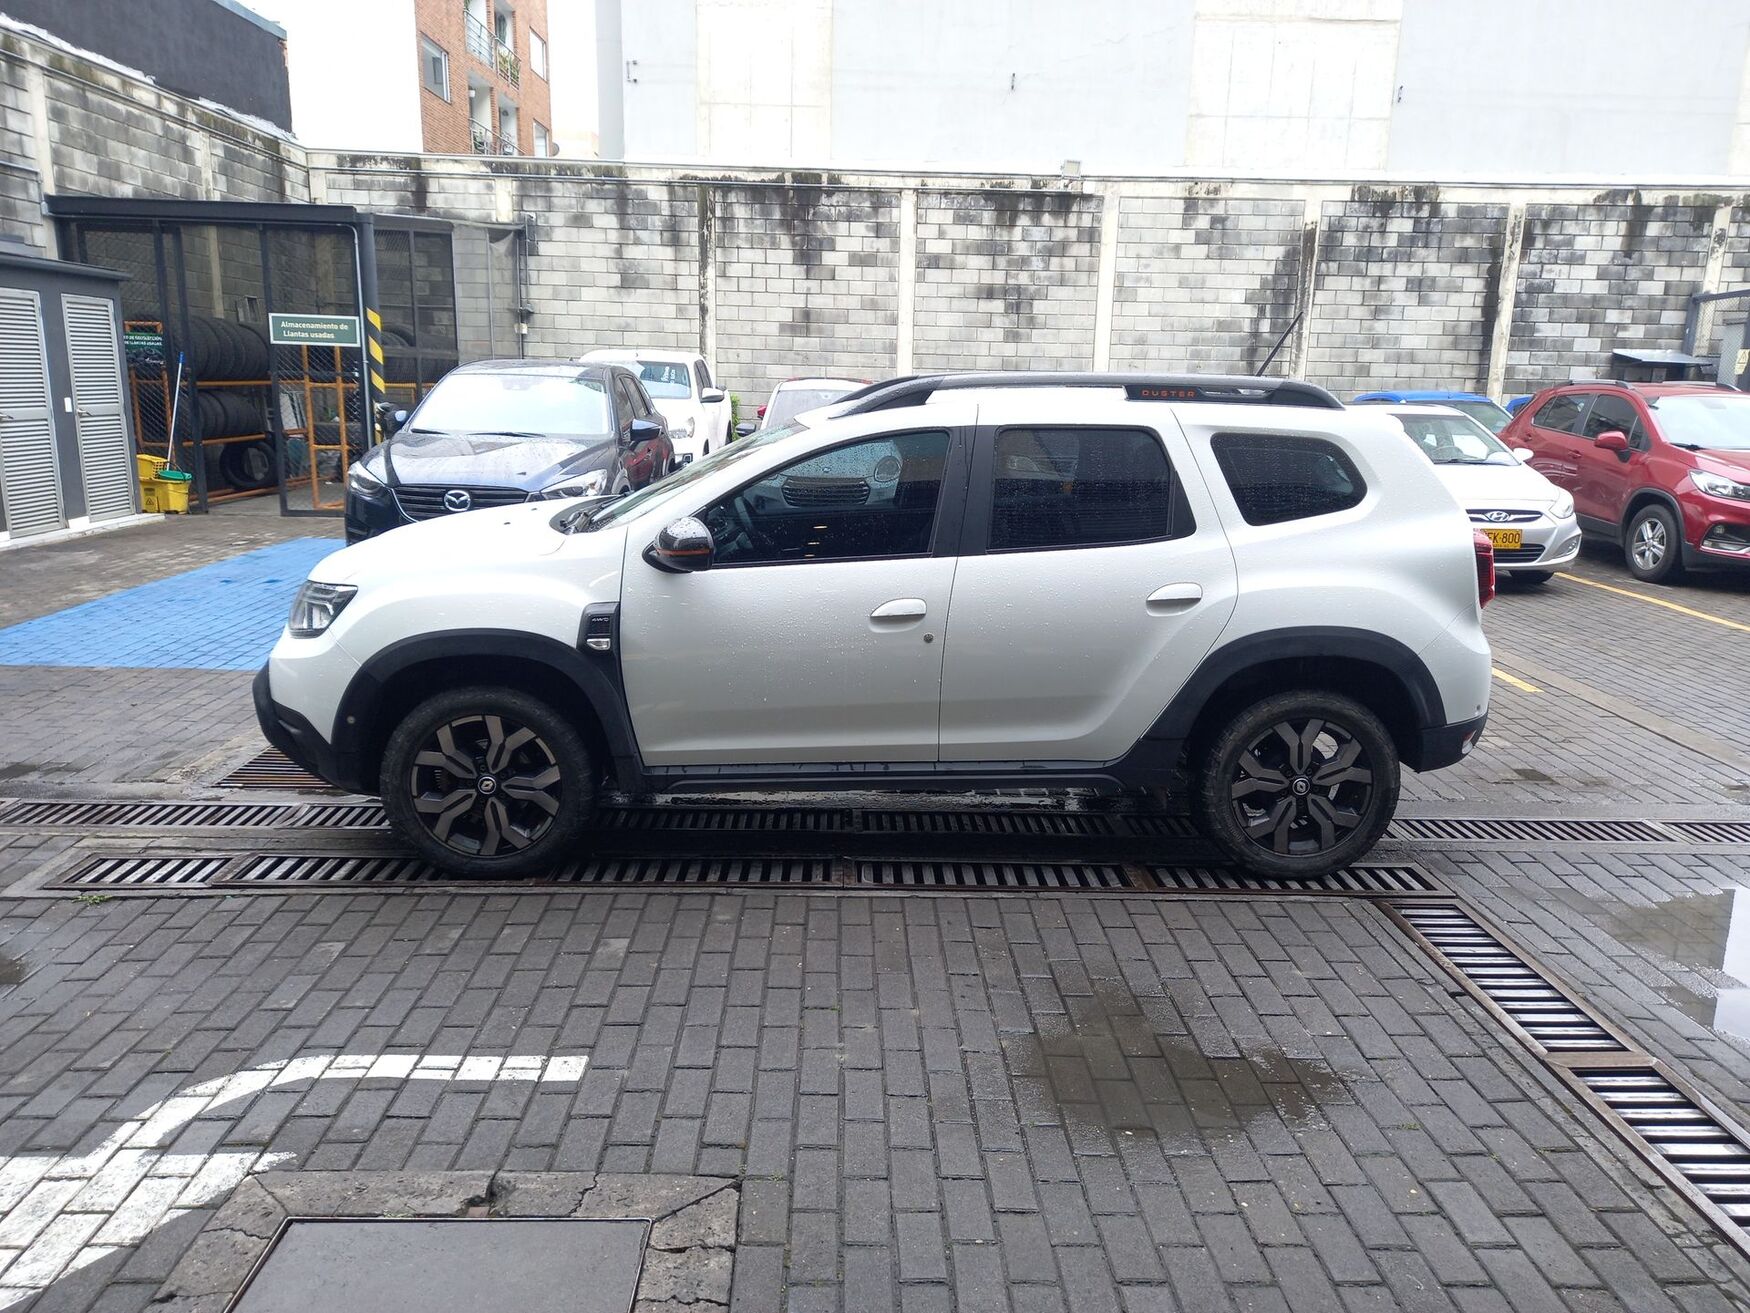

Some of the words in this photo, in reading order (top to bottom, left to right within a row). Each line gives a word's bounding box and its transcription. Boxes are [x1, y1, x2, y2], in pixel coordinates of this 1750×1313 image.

[281, 321, 338, 329] Almacenamiento
[283, 330, 309, 338] Llantas
[1141, 389, 1196, 398] DUSTER
